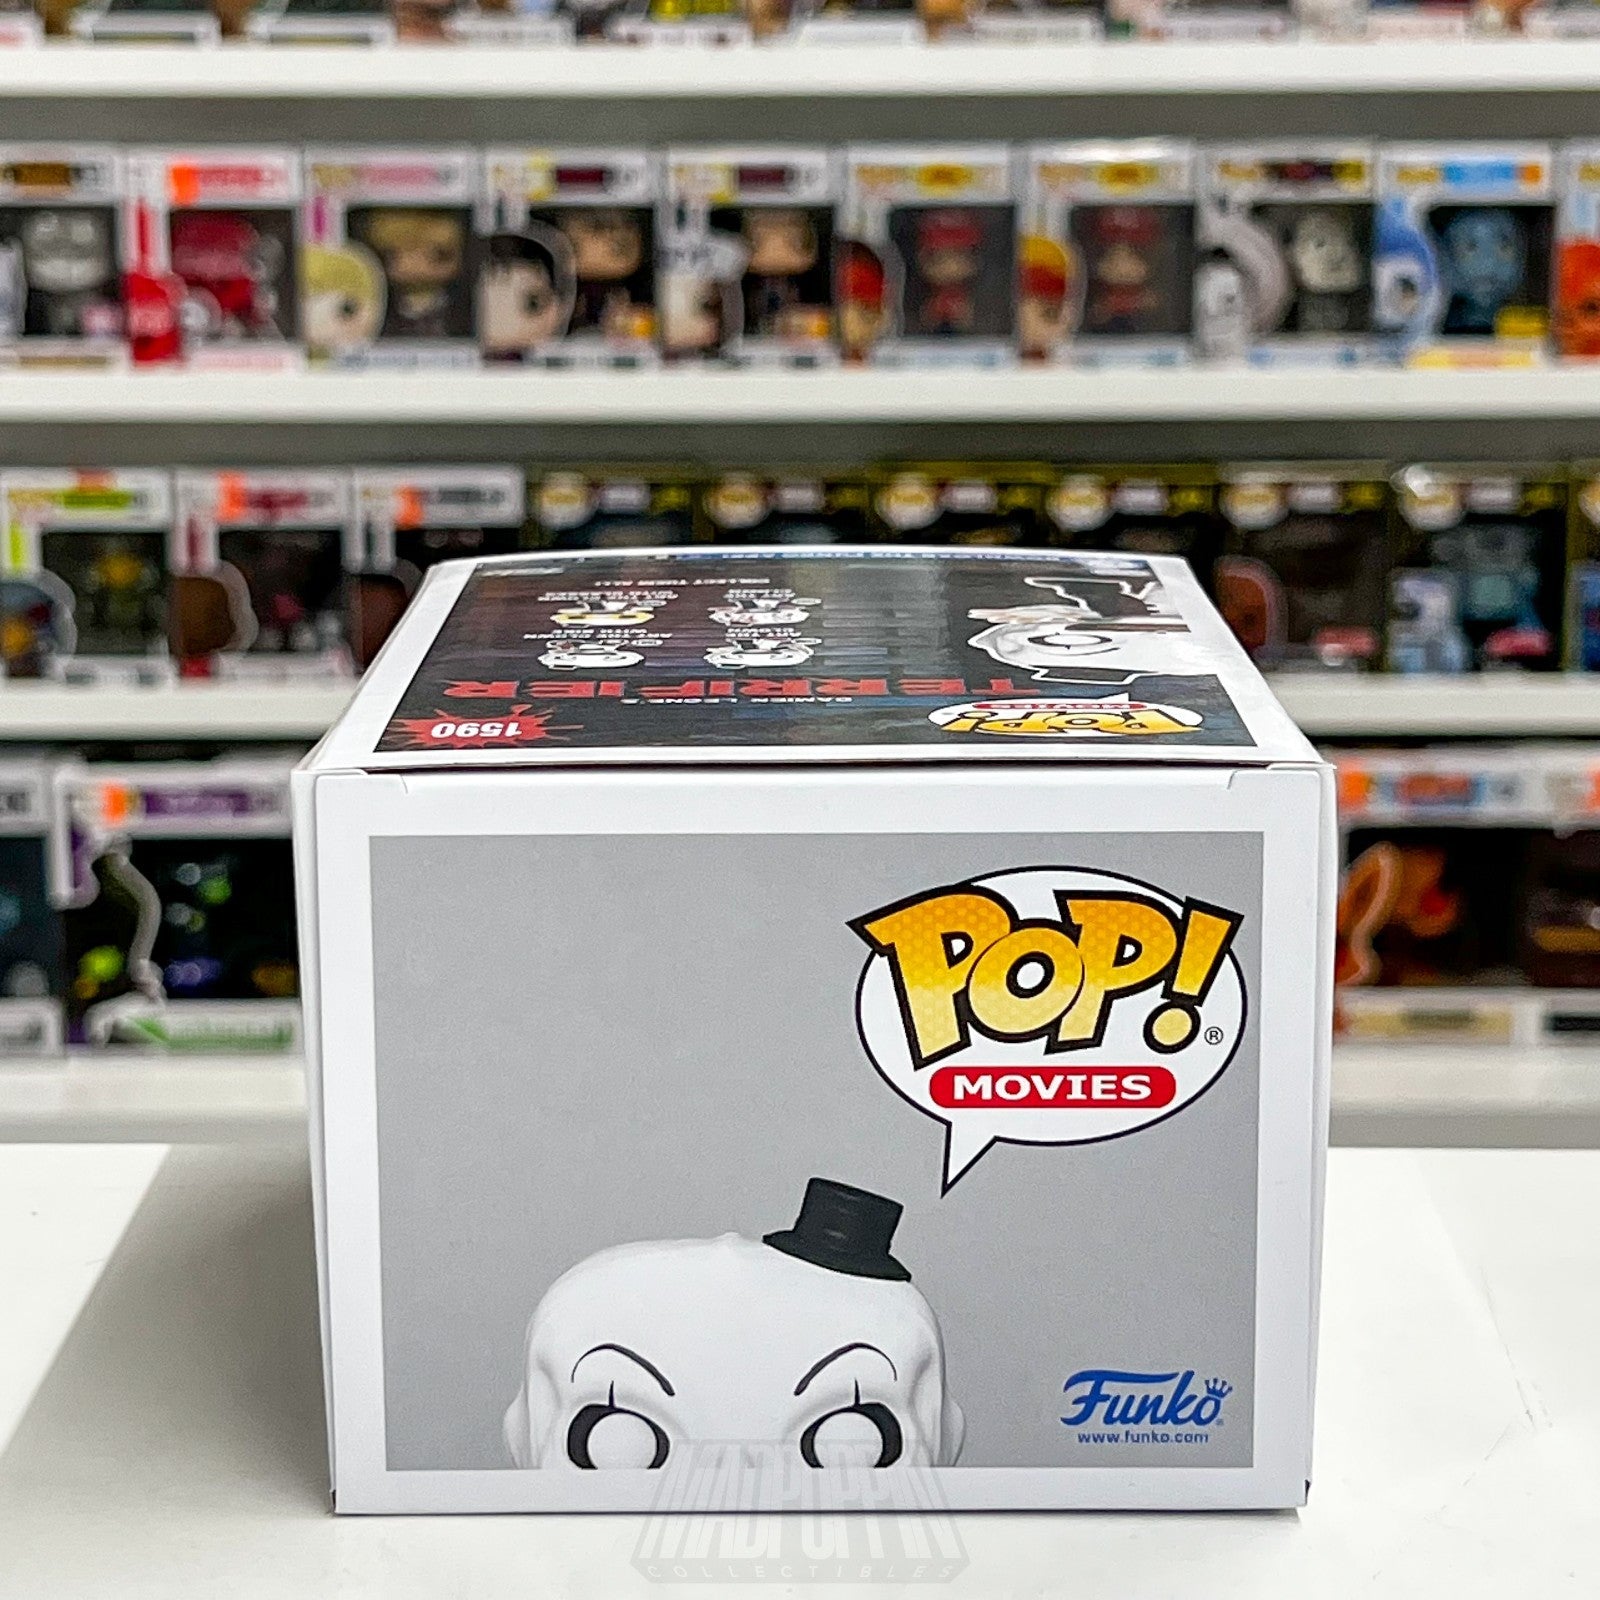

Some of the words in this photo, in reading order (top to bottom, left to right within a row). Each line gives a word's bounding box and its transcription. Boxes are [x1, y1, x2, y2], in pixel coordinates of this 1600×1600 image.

[443, 678, 1040, 699] TERRIFIER
[620, 697, 739, 705] LEONE'S
[430, 722, 523, 738] 1590
[939, 709, 1204, 736] POP!
[846, 884, 1244, 1071] POP!
[952, 1073, 1152, 1101] MOVIES
[1060, 1369, 1222, 1426] Funko
[1077, 1430, 1209, 1444] www.funko.com
